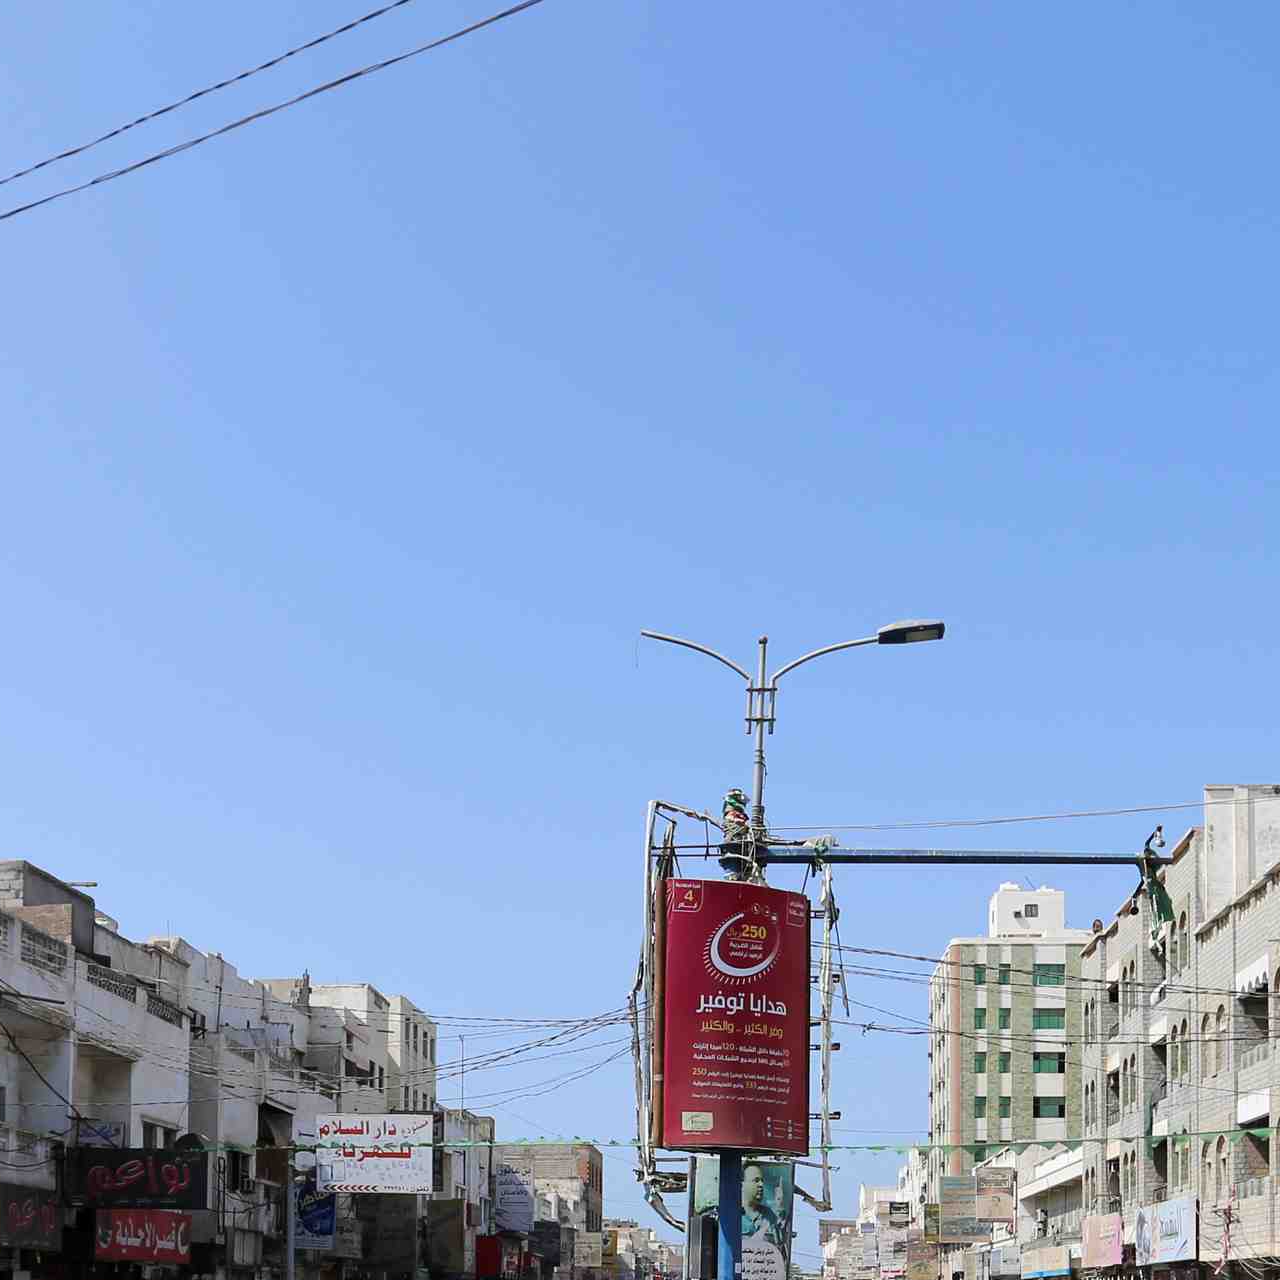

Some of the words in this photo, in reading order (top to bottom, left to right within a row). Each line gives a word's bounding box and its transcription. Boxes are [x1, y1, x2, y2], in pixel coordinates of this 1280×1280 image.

[741, 924, 767, 940] 250
[695, 990, 745, 1015] توفير
[749, 992, 787, 1016] هدايا
[319, 1119, 369, 1138] السلام
